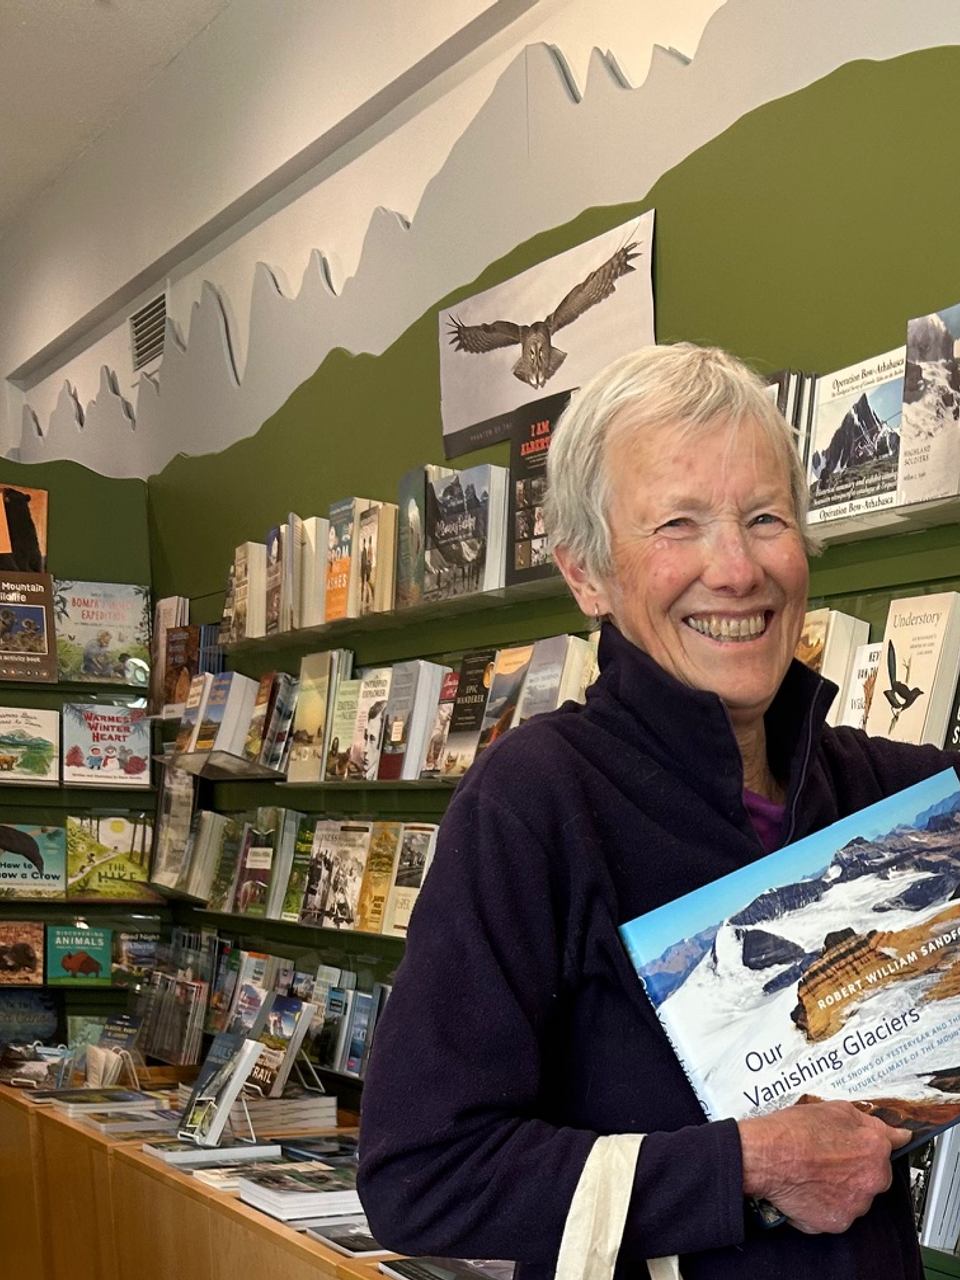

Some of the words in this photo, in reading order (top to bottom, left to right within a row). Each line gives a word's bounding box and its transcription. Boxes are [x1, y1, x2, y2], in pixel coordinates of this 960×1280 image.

[1, 582, 45, 593] Mountain
[893, 611, 943, 629] Understory
[86, 722, 132, 733] WINTER
[92, 732, 130, 743] HEART
[31, 871, 61, 880] Crow
[55, 936, 104, 946] ANIMALS
[815, 979, 865, 1012] ROBERT
[865, 950, 919, 985] WILLIAM
[842, 1007, 920, 1056] Glaciers
[744, 1043, 784, 1073] Our
[831, 1078, 846, 1089] THE
[847, 1063, 874, 1082] SNOWS
[875, 1056, 887, 1068] OF
[886, 1032, 930, 1060] YESTERYEAR
[931, 1023, 948, 1035] AND
[743, 1047, 843, 1108] Vanishing
[848, 1078, 876, 1093] FUTURE
[877, 1057, 910, 1080] CLIMATE
[910, 1051, 921, 1060] OF
[921, 1044, 936, 1056] THE
